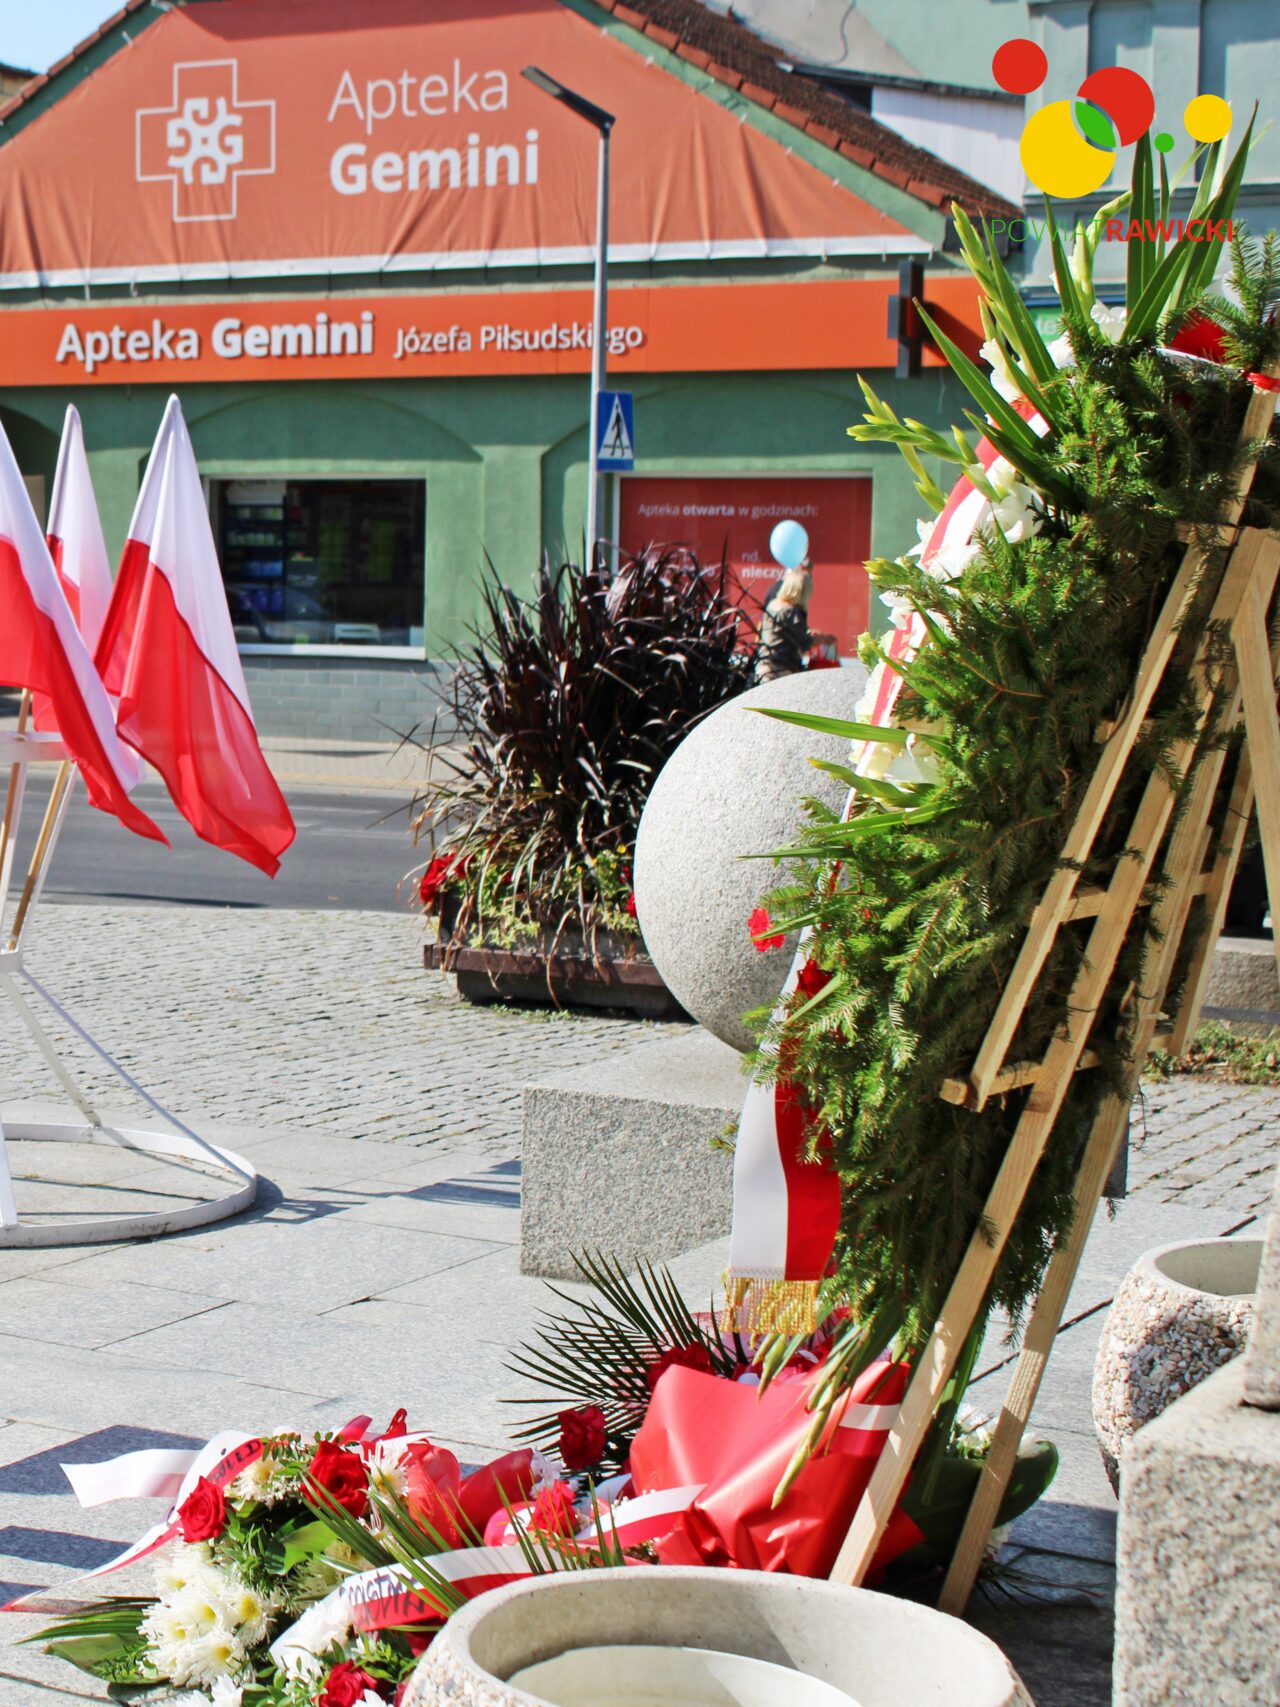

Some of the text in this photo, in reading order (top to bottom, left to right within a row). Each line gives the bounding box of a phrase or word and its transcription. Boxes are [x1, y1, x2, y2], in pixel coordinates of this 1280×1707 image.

[328, 59, 508, 135] Apteka
[330, 129, 539, 195] Gemini
[55, 311, 643, 373] Apteka Gemini Józefa Piłsudskigo
[639, 503, 680, 517] Apteka
[683, 504, 735, 516] otwarta
[738, 506, 749, 516] w
[741, 567, 785, 581] nieczy
